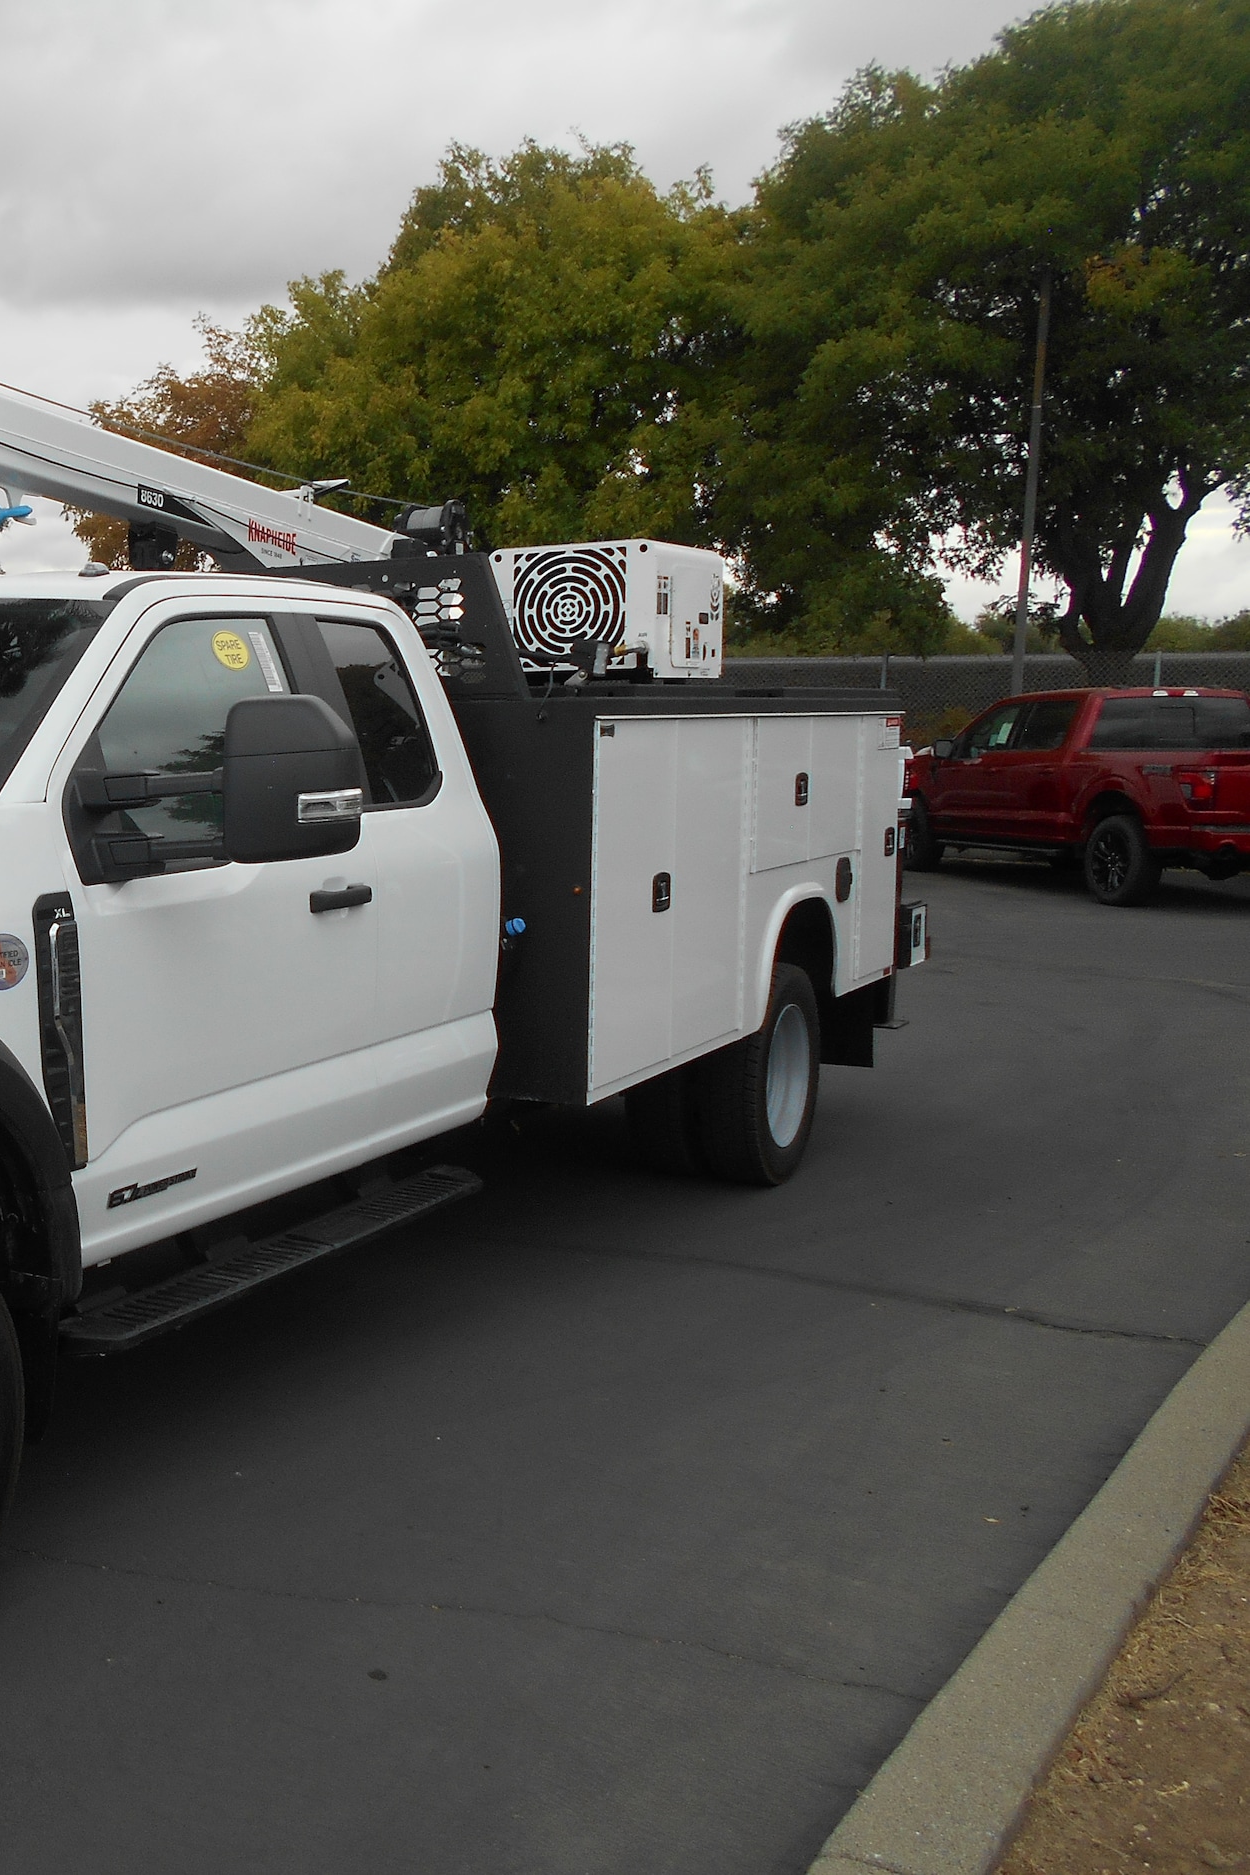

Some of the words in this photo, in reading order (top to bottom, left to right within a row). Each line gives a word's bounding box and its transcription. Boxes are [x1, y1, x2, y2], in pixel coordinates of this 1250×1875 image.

[140, 489, 164, 508] 8630
[248, 518, 297, 556] KNAPHEIDE
[215, 639, 242, 651] SPARE
[224, 653, 244, 665] TIRE
[53, 907, 71, 919] XL
